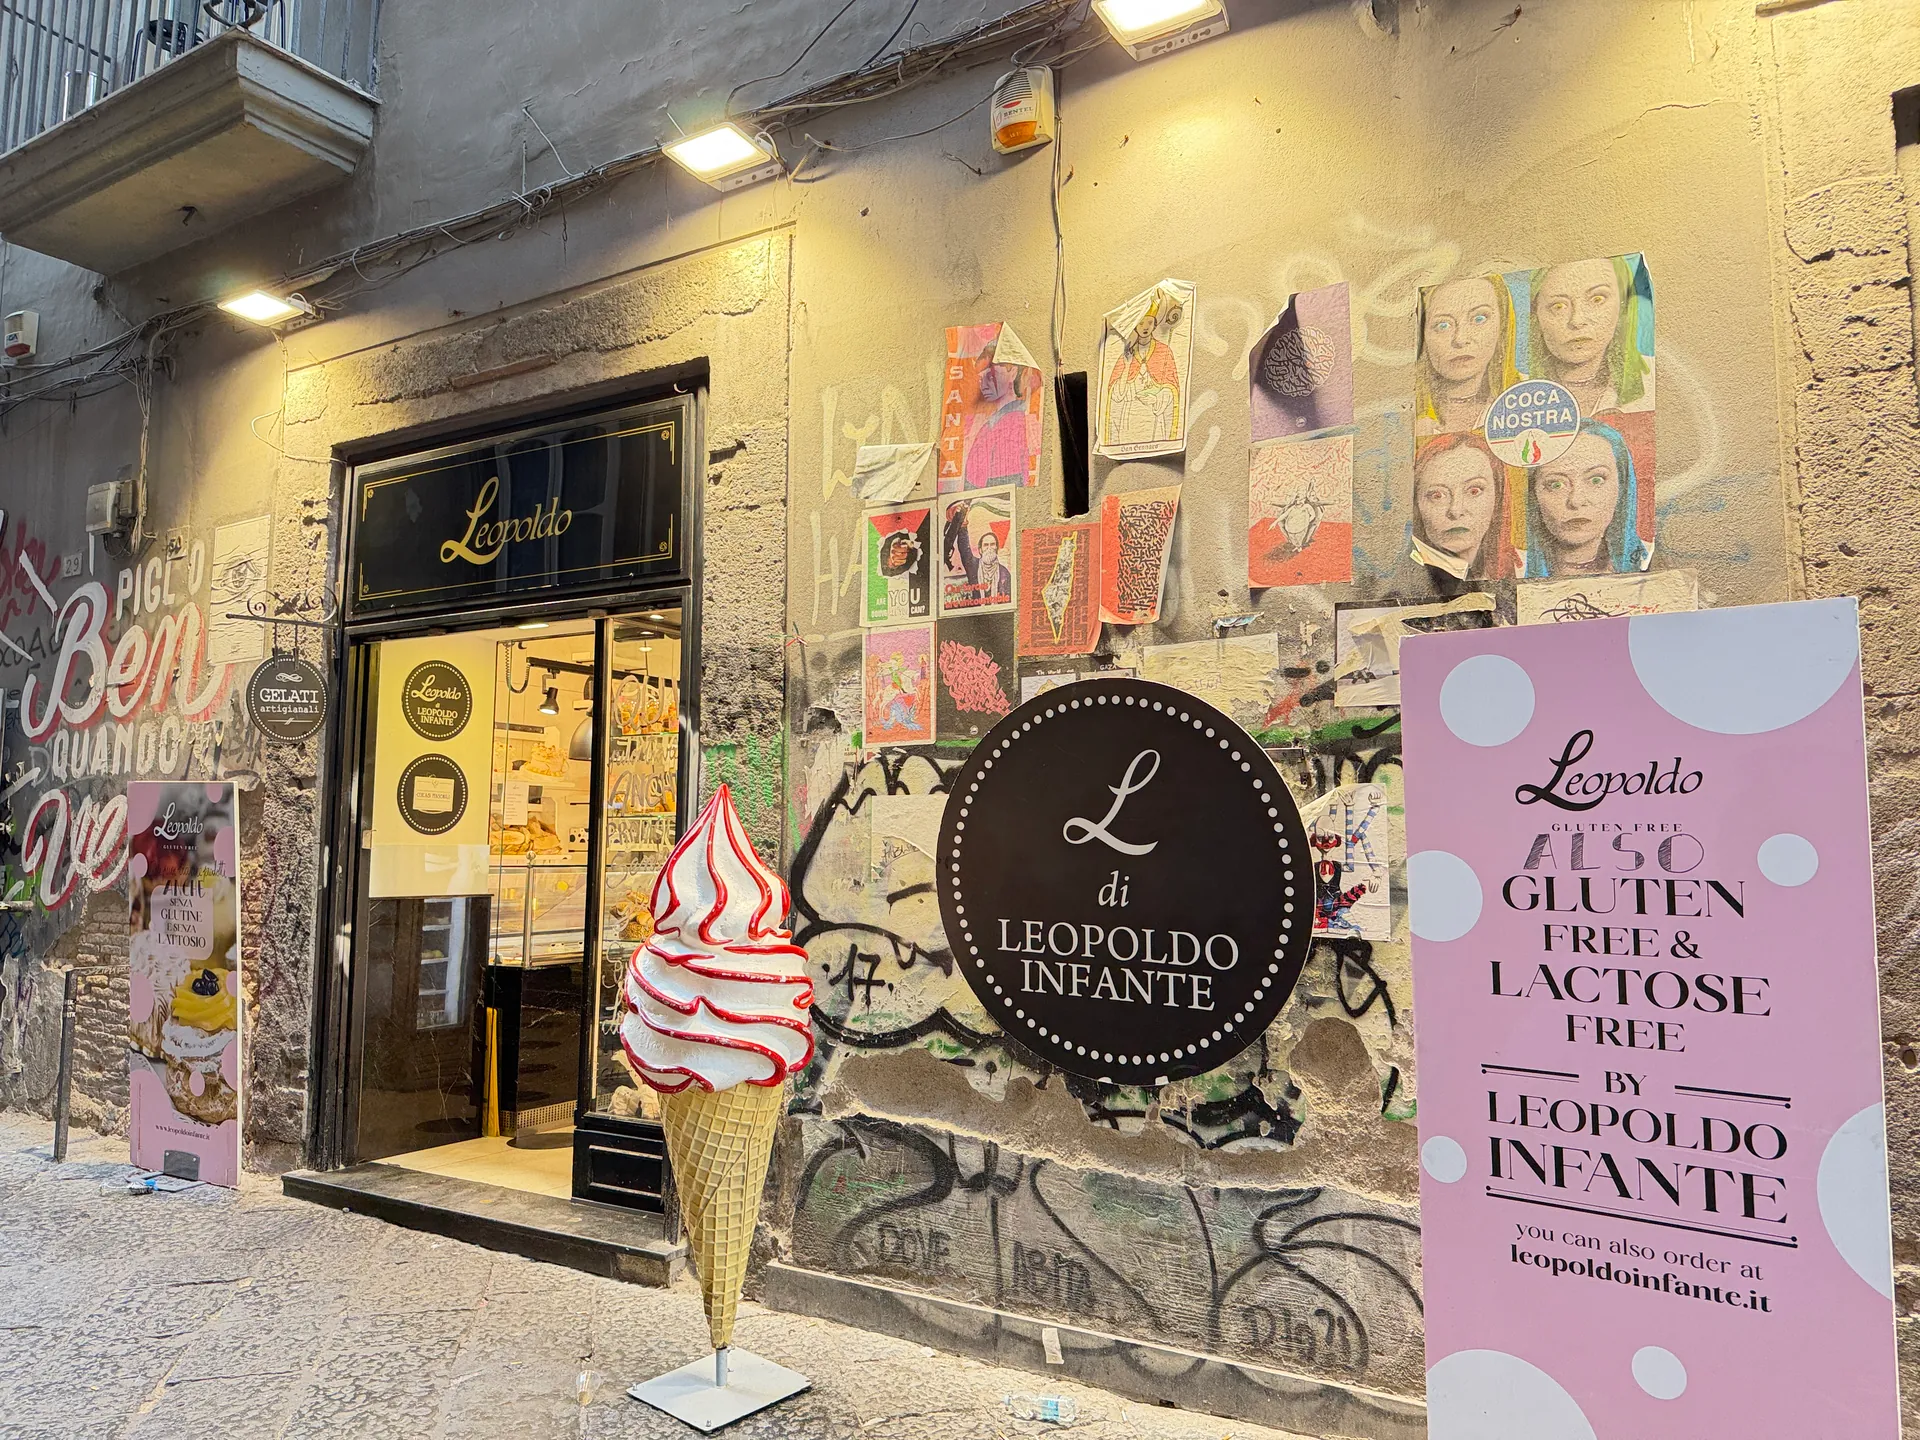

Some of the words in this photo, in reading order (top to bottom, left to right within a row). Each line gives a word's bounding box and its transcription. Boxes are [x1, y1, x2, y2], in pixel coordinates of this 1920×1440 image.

[1504, 389, 1561, 410] COCA
[1491, 407, 1573, 431] NOSTRA
[440, 476, 574, 565] Leopoldo
[65, 557, 80, 576] 29
[888, 587, 921, 607] YOU
[259, 687, 320, 704] GELATI
[411, 674, 462, 702] Leopoldo
[259, 704, 320, 715] artigianali
[416, 706, 459, 719] LEOPOLDO
[420, 715, 455, 726] INFANTE
[51, 716, 180, 783] QUANDO
[1514, 729, 1704, 812] Leopoldo
[1062, 748, 1161, 856] L
[153, 801, 205, 841] Leopoldo
[1550, 822, 1624, 833] GLUTEN
[1633, 822, 1684, 833] FREE
[1522, 832, 1705, 874] ALSO
[169, 898, 193, 909] SENZA
[1097, 870, 1130, 907] di
[1500, 874, 1746, 919] GLUTEN
[160, 907, 203, 923] GLUTINE
[172, 923, 197, 934] SENZA
[157, 933, 207, 949] LATTOSIO
[997, 918, 1240, 971] LEOPOLDO
[1543, 923, 1660, 959] FREE
[1669, 930, 1704, 960] &
[1019, 958, 1216, 1012] INFANTE
[1489, 960, 1772, 1017] LACTOSE
[1565, 1013, 1686, 1053] FREE
[1603, 1071, 1648, 1097] BY
[1486, 1090, 1789, 1161] LEOPOLDO
[1487, 1135, 1788, 1224] INFANTE
[1514, 1222, 1555, 1244] you
[1561, 1232, 1602, 1251] can
[1608, 1237, 1656, 1261] also
[1662, 1246, 1732, 1275] order
[1739, 1261, 1764, 1281] at
[1510, 1243, 1773, 1313] leopoldoinfante.it
